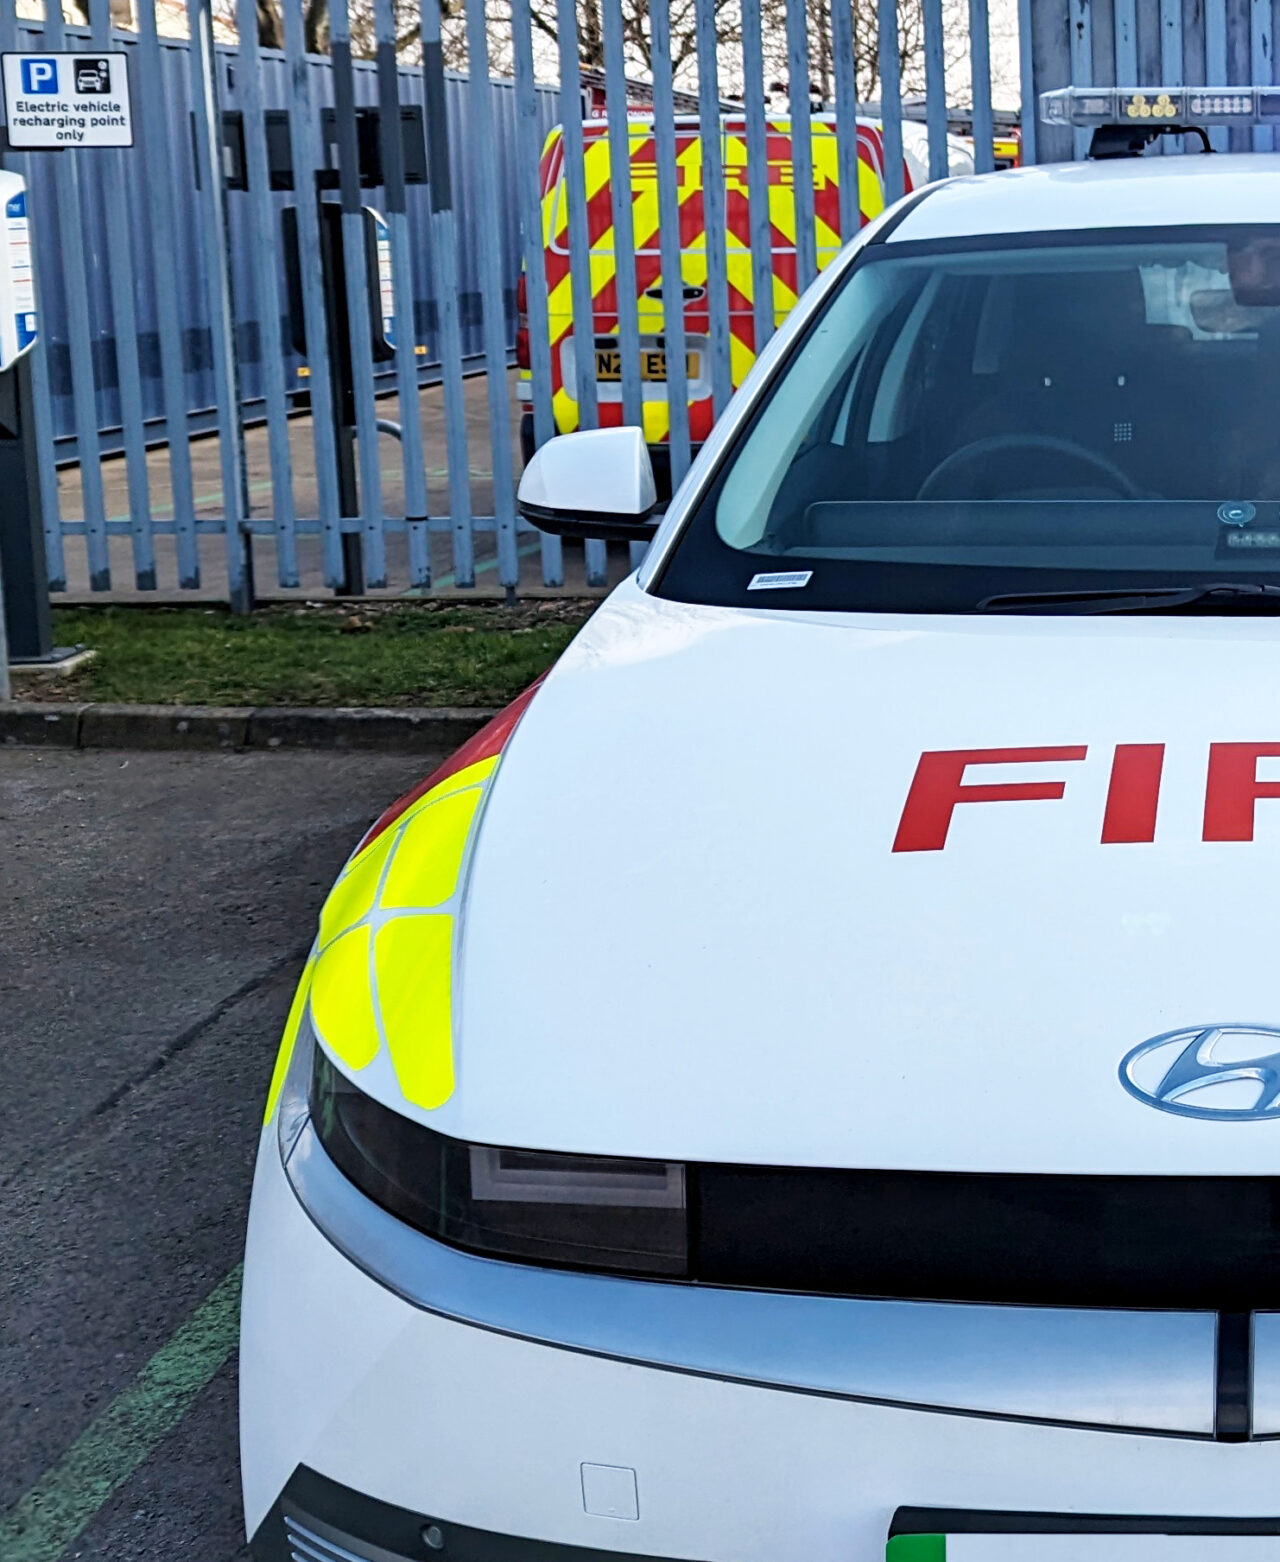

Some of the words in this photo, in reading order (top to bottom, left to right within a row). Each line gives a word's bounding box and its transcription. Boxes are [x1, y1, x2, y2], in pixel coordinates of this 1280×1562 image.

[29, 62, 53, 91] P
[16, 101, 69, 112] Electric
[73, 101, 121, 112] vehicle
[13, 115, 85, 128] recharging
[90, 115, 126, 128] point
[56, 129, 84, 142] only
